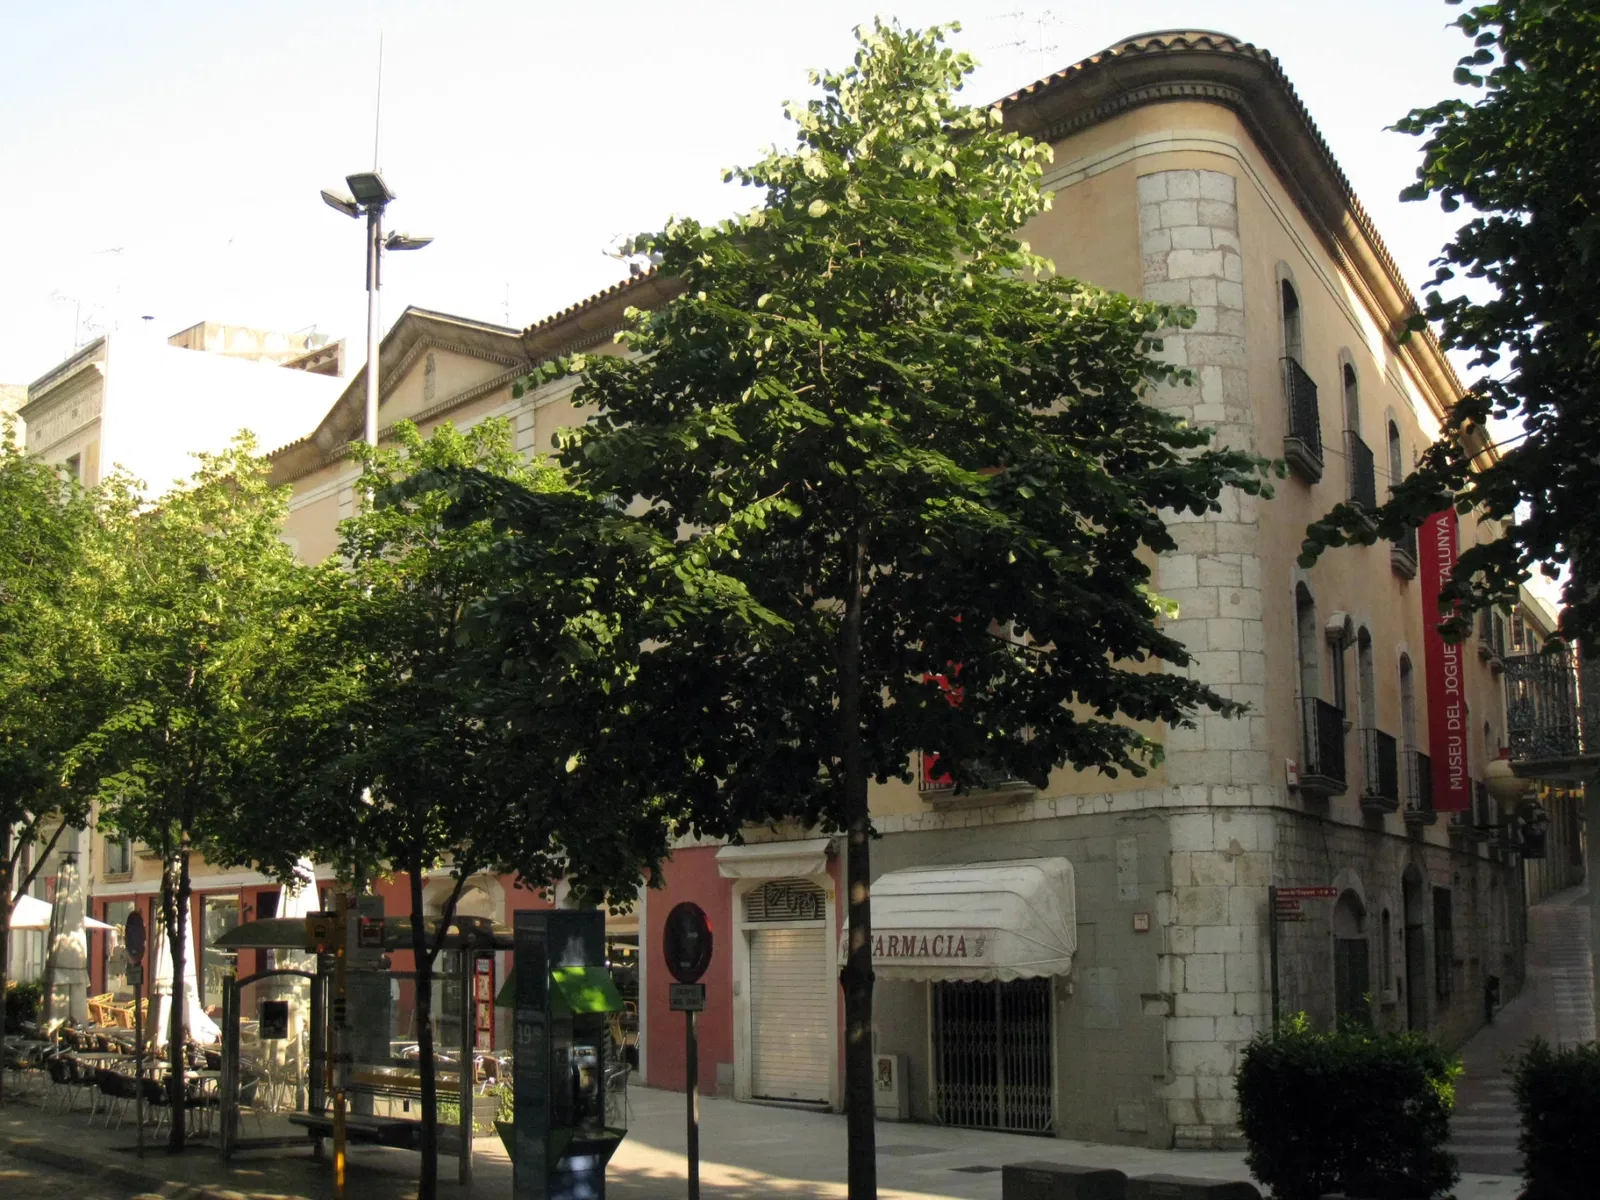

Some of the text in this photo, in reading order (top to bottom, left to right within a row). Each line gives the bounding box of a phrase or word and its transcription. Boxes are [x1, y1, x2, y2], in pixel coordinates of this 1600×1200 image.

[1443, 643, 1460, 696] JOGUE
[1446, 700, 1461, 731] DEL
[1448, 736, 1463, 790] MUSEU
[870, 934, 968, 958] ARMACIA
